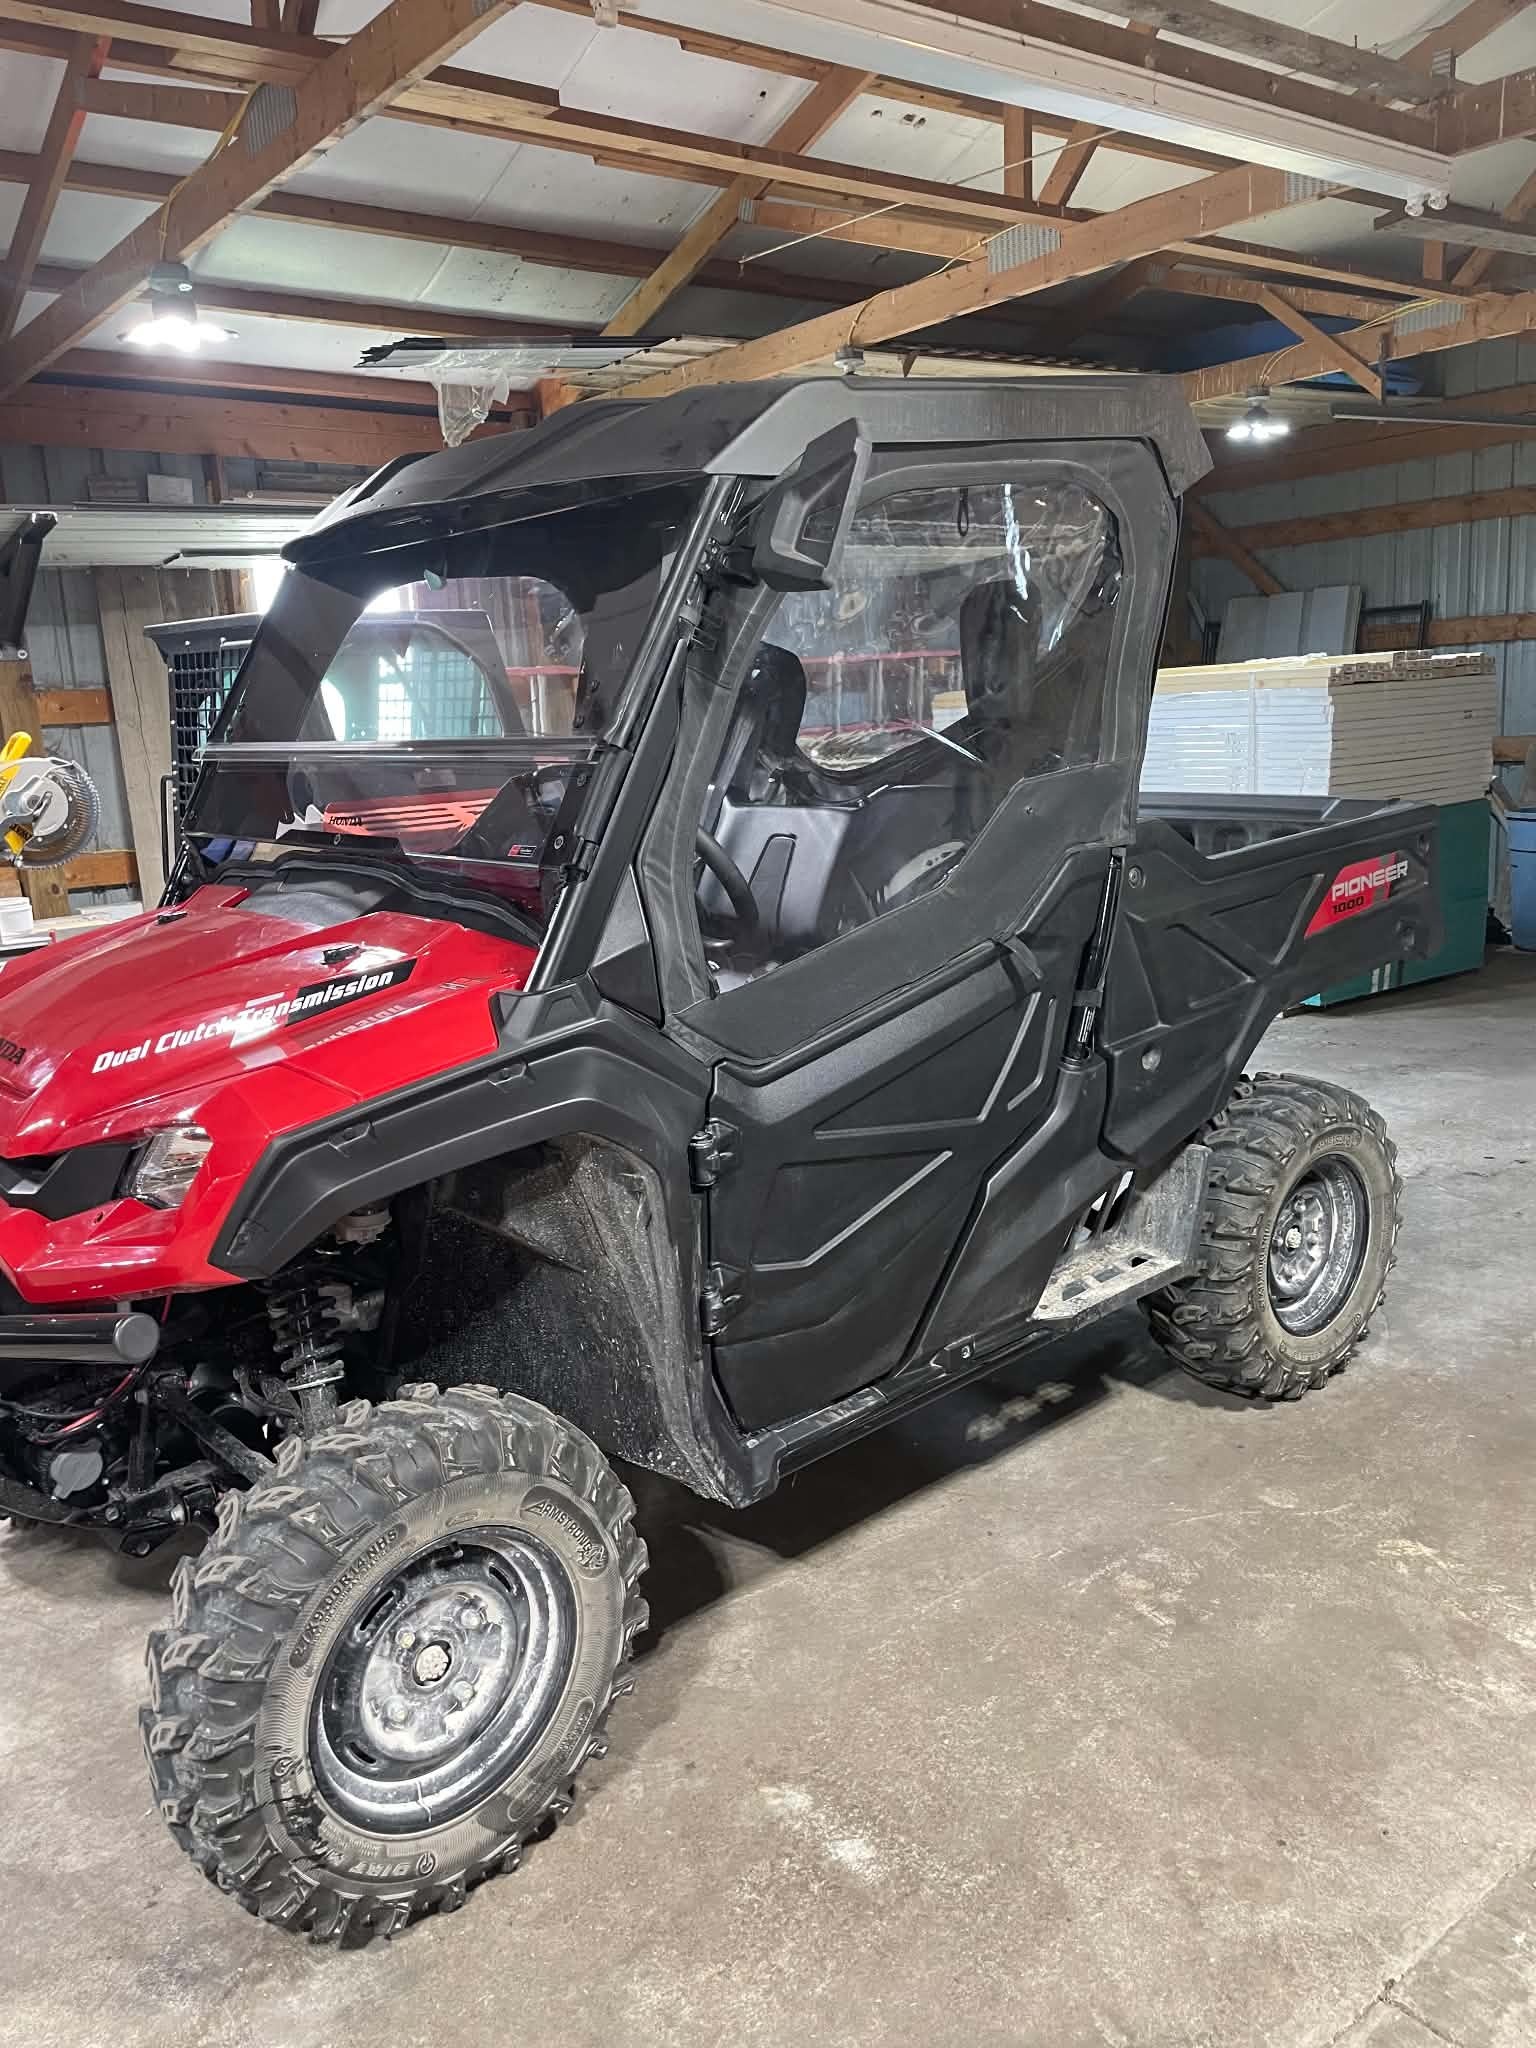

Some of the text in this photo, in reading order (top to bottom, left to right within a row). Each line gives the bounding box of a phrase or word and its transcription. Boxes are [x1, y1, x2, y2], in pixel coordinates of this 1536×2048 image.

[328, 815, 363, 827] HONDA
[1332, 860, 1409, 902] PIONEER
[1333, 896, 1364, 914] 1000
[92, 1038, 152, 1073] Dual
[154, 1015, 234, 1053] Clutch
[236, 970, 394, 1028] Transmission
[520, 1499, 594, 1555] ARMSTRONG
